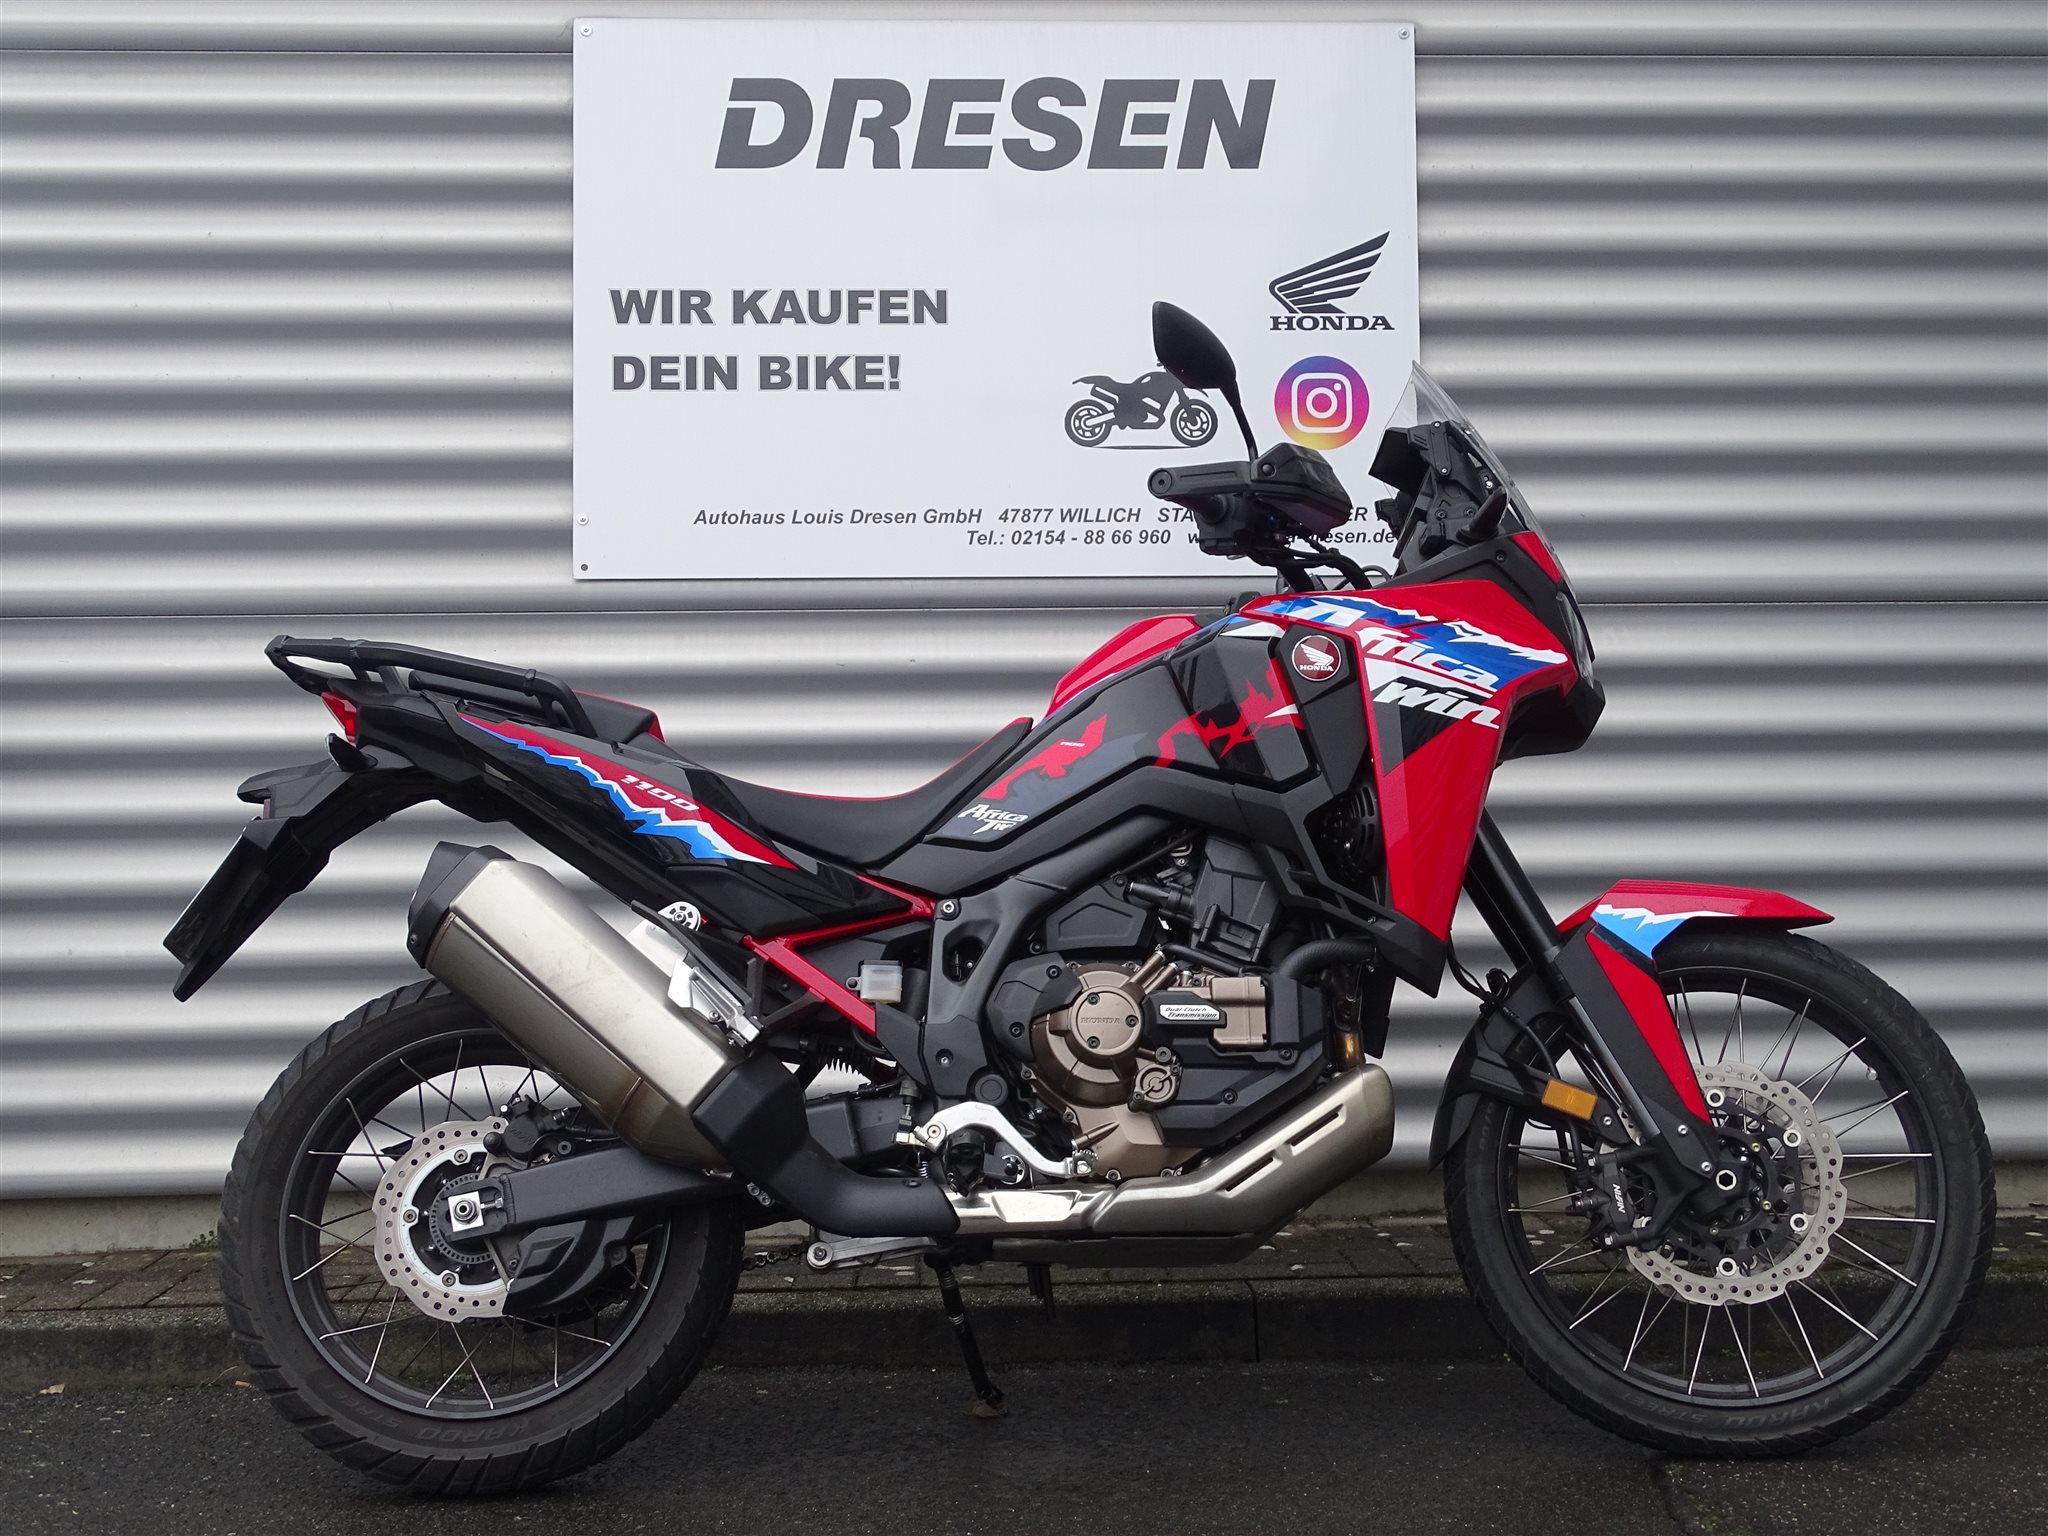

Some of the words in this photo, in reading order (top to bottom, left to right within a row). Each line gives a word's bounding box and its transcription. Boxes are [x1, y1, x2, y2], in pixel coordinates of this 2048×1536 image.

[715, 76, 1276, 172] DRESEN
[609, 289, 714, 325] WIR
[732, 289, 948, 325] KAUFEN
[1269, 315, 1396, 331] HONDA
[612, 355, 739, 391] DEIN
[758, 354, 902, 391] BIKE!
[693, 509, 785, 525] Autohaus
[791, 509, 844, 525] Louis
[849, 509, 917, 524] Dresen
[923, 508, 983, 524] GmbH
[998, 508, 1054, 524] 47877
[1060, 507, 1141, 523] WILLICH
[967, 530, 1005, 546] Tel.:
[1011, 530, 1066, 545] 02154
[1083, 529, 1106, 545] 88
[1111, 529, 1133, 545] 66
[1138, 529, 1171, 545] 960
[1299, 664, 1335, 672] HONDA
[620, 774, 700, 811] 1100
[957, 803, 1029, 822] Africa
